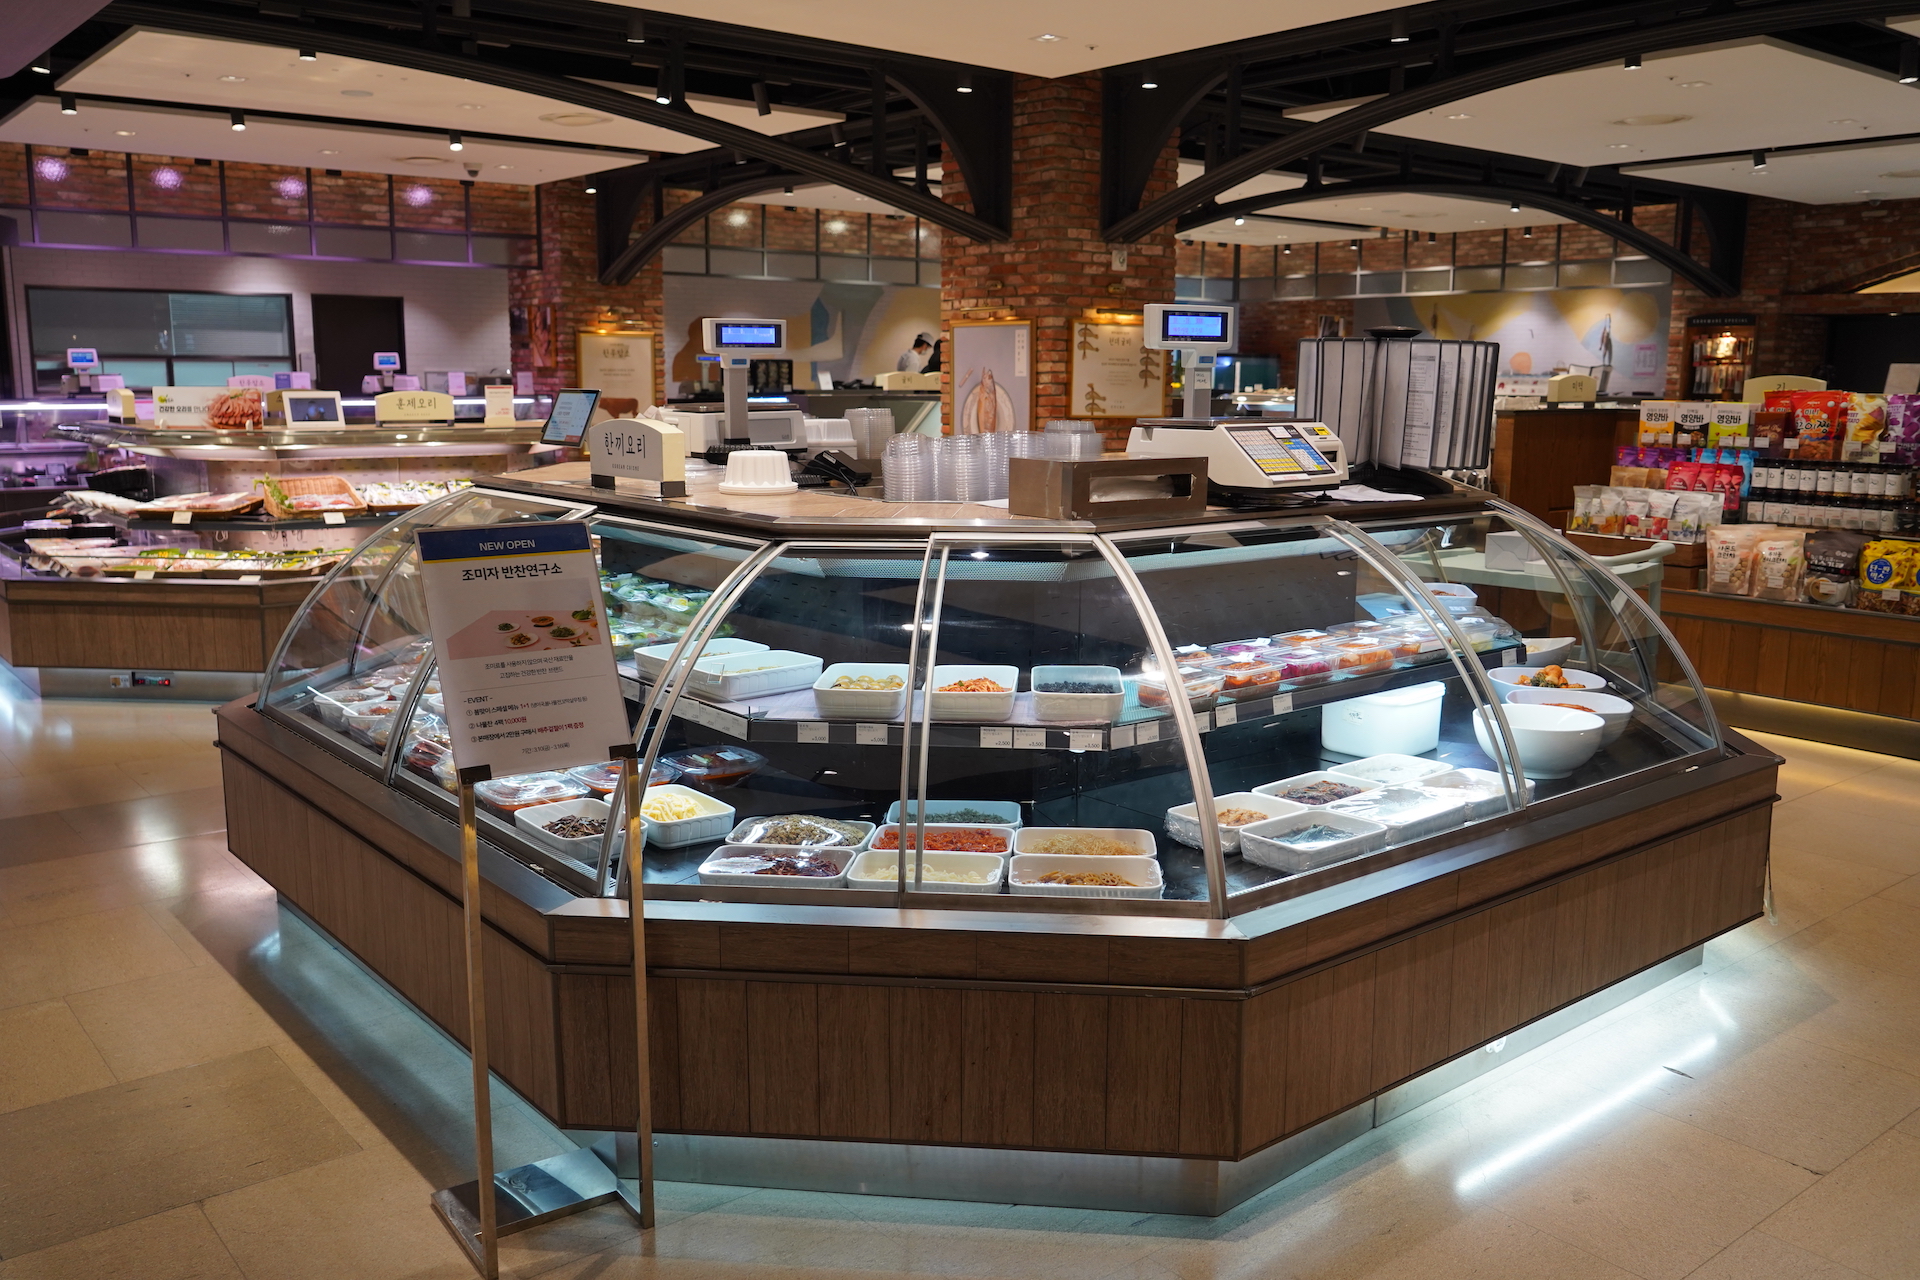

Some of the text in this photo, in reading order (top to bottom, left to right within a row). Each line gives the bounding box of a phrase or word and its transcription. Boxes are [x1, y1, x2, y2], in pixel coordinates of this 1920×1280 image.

[396, 397, 436, 410] 훈제오리
[159, 405, 175, 413] 건강한
[177, 405, 192, 413] 오리를
[1646, 412, 1668, 422] 영양바
[1681, 414, 1704, 423] 영양바
[1717, 414, 1741, 424] 영양바
[605, 432, 646, 459] 한끼요리
[479, 539, 536, 551] NEW OPEN
[462, 563, 563, 581] 조미자 반찬연구소
[484, 661, 506, 670] 조미료를
[506, 659, 527, 668] 사용하지
[543, 656, 553, 664] 국산
[520, 669, 537, 677] 건강한
[467, 695, 489, 704] EVENT
[474, 706, 491, 716] 봄맞이
[504, 715, 527, 725] 10,000원
[477, 730, 505, 743] 본매장에서
[505, 730, 520, 738] 2만원
[520, 728, 537, 736] 구매시
[573, 721, 585, 729] 증정
